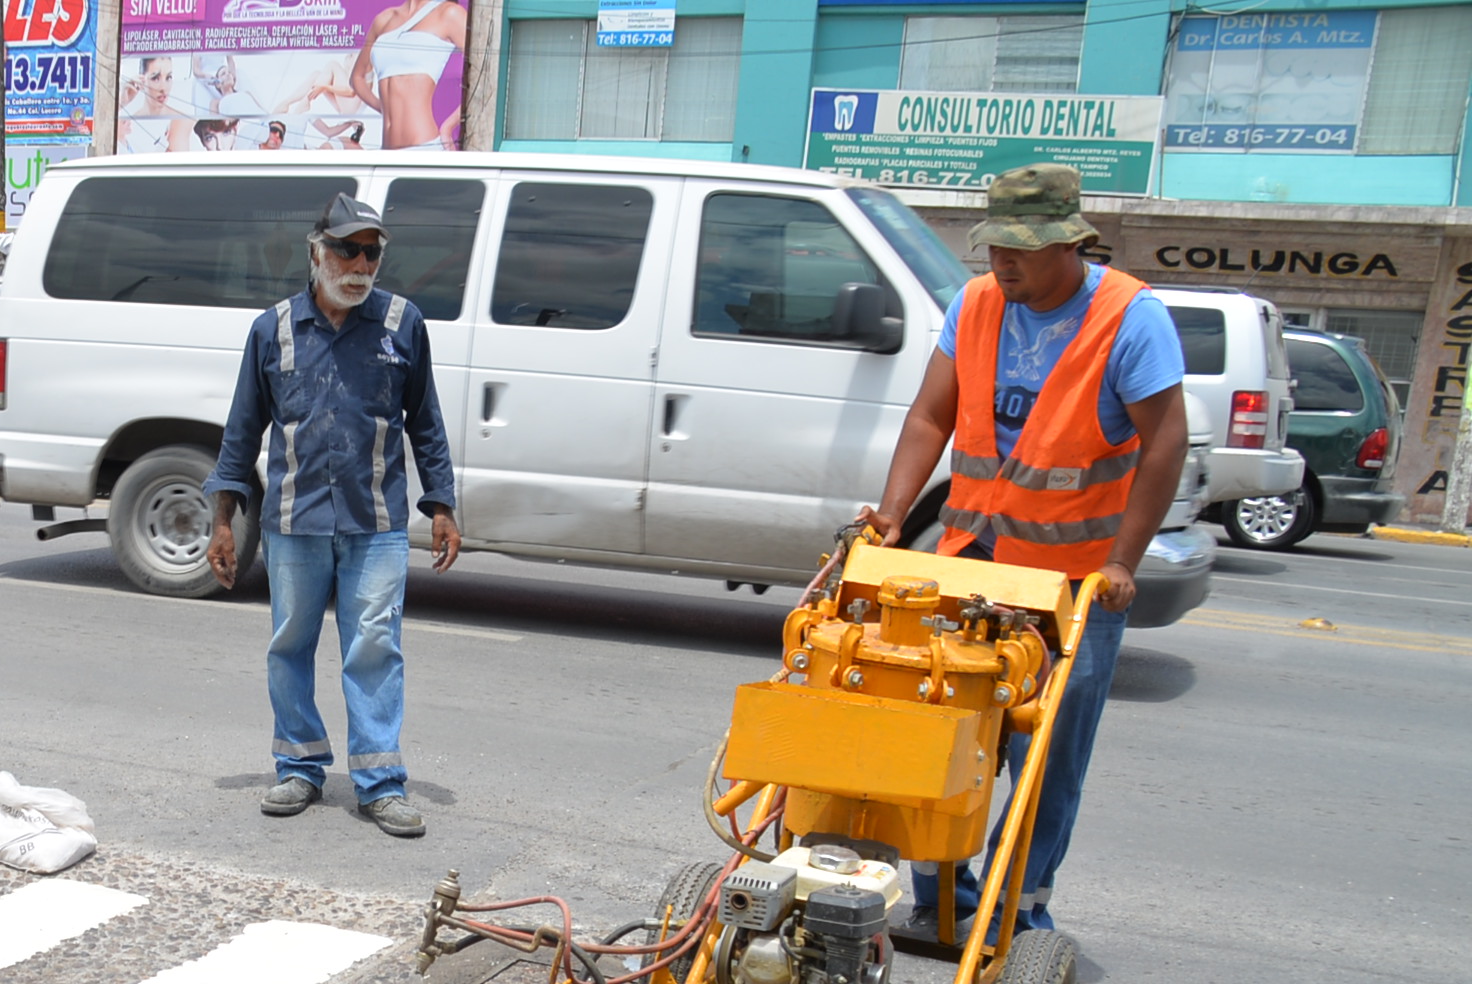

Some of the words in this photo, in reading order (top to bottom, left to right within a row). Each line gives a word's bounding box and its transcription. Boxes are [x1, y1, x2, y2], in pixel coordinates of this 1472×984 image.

[1221, 13, 1329, 29] DENTISTA
[598, 33, 617, 45] Tel:
[619, 33, 673, 45] 816-77-04
[1184, 33, 1214, 46] Dr.
[1220, 31, 1281, 45] Carlos
[1288, 32, 1308, 44] A.
[1316, 30, 1365, 43] Mtz.
[898, 96, 1035, 135] CONSULTORIO
[1039, 99, 1116, 138] DENTAL
[1173, 127, 1215, 144] Tel:
[1223, 128, 1347, 145] 816-77-04
[1155, 246, 1398, 278] COLUNGA
